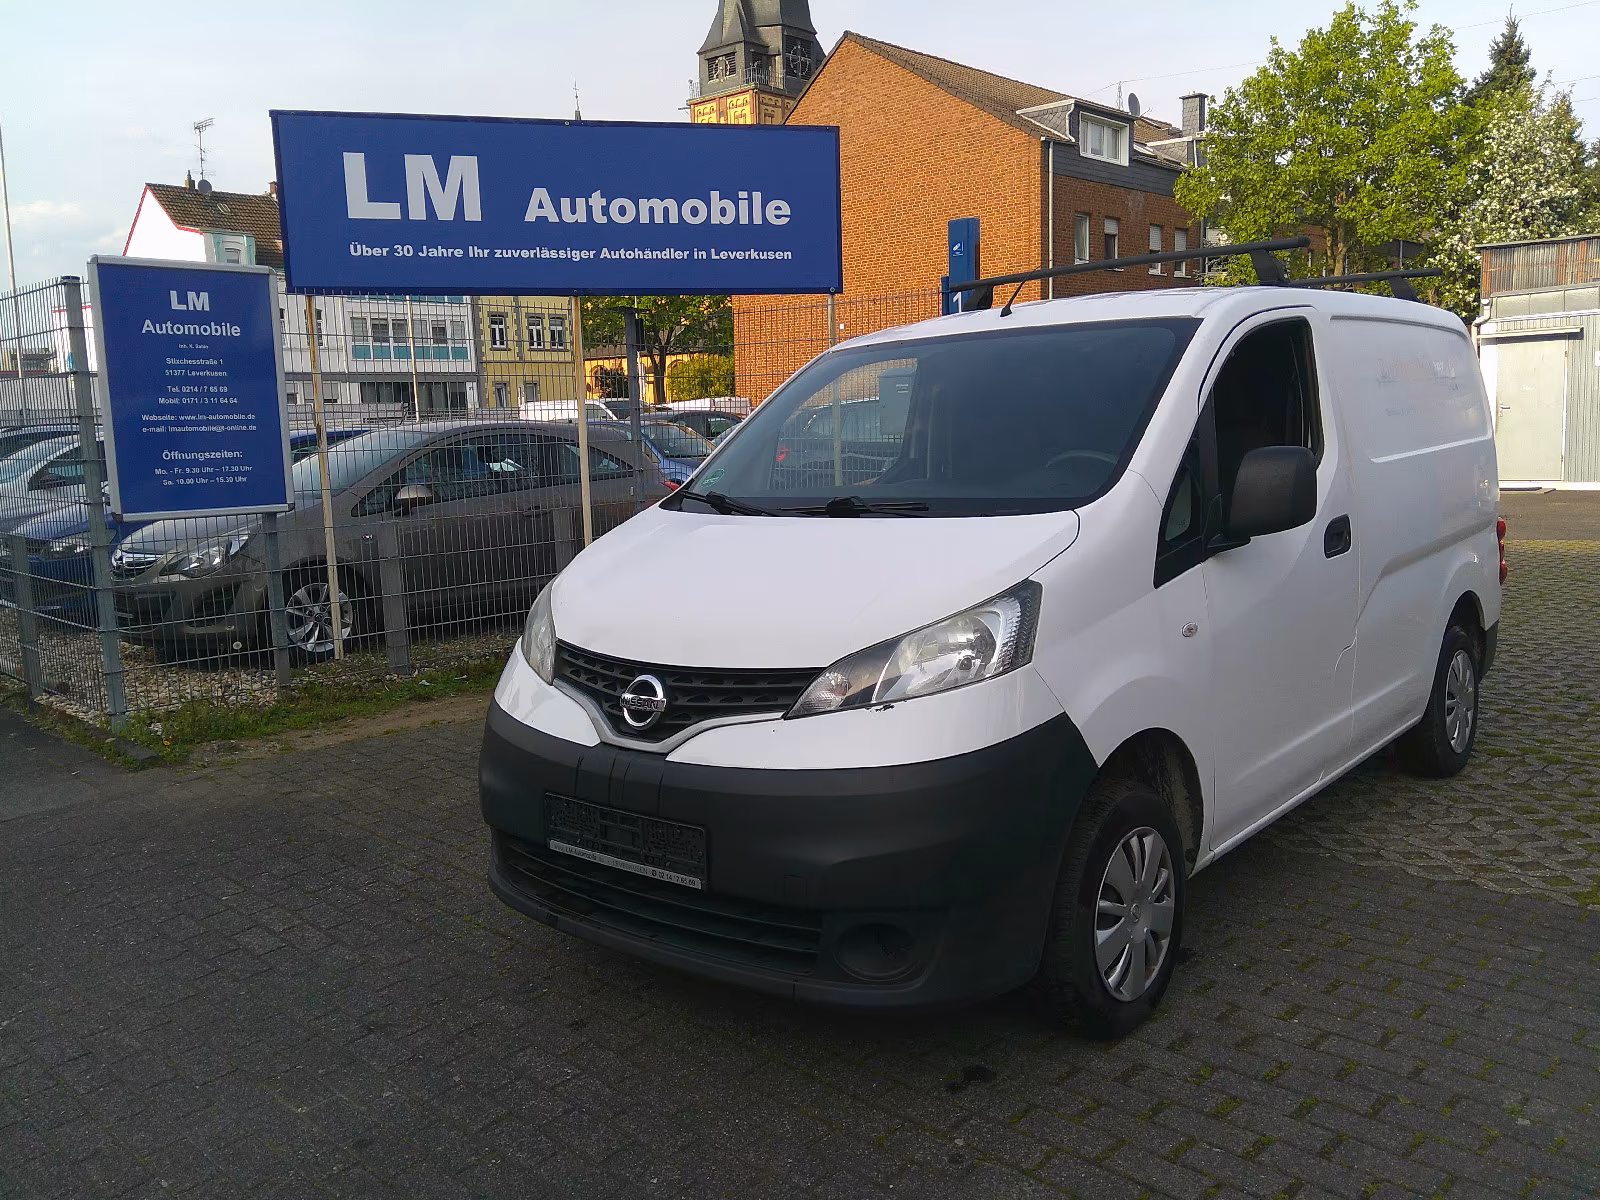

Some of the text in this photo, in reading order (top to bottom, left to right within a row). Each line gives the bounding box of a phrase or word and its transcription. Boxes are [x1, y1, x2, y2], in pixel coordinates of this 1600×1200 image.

[343, 151, 791, 226] LM Automobile
[350, 242, 792, 262] Über 30 Jahre Ihr zuverlässiger Autohändler in Leverkusen
[169, 290, 210, 311] LM
[142, 319, 241, 337] Automobile
[165, 357, 218, 365] Stixchesstraße
[187, 369, 227, 377] Leverkusen
[181, 385, 199, 393] 0214
[162, 449, 243, 461] Öffnungszeiten:
[622, 695, 659, 711] NISSAN
